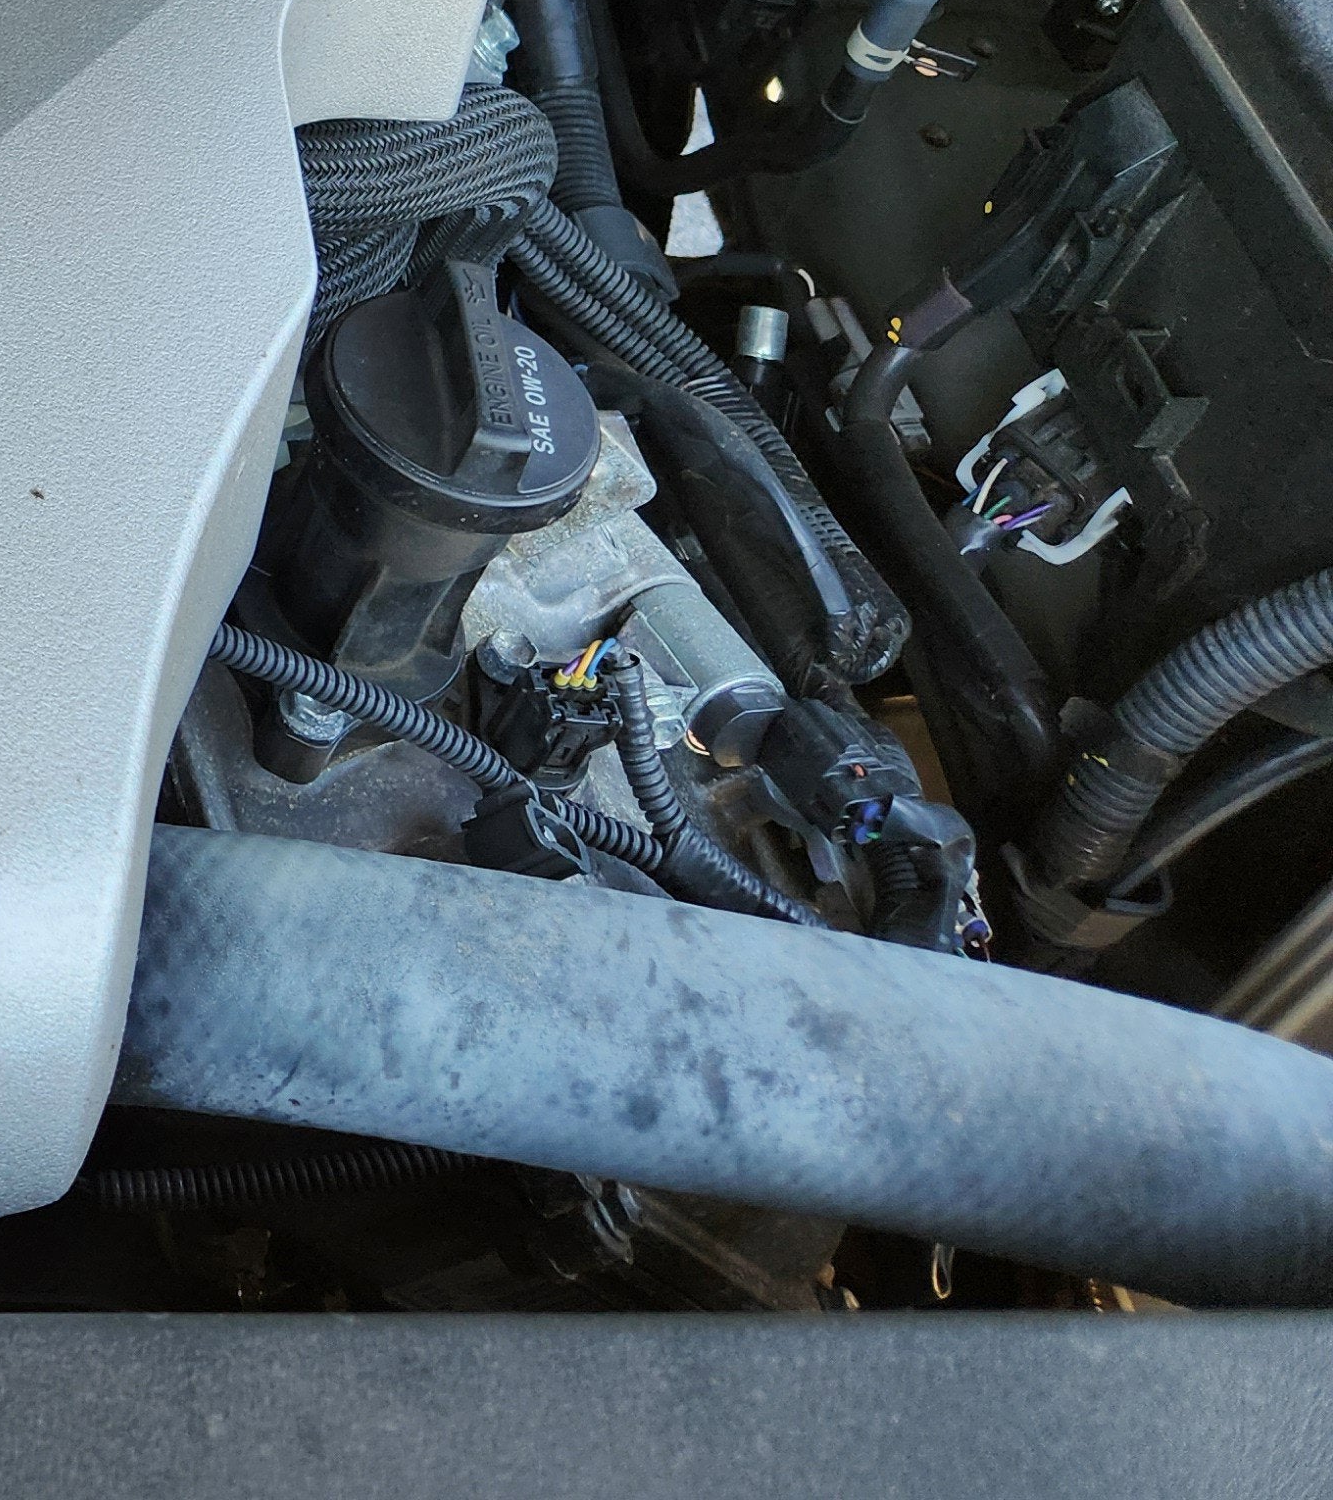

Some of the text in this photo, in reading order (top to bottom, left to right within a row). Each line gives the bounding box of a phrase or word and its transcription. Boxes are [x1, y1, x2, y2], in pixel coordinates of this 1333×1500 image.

[472, 319, 514, 427] ENGINE OIL
[514, 345, 555, 455] SAE 0W-20
